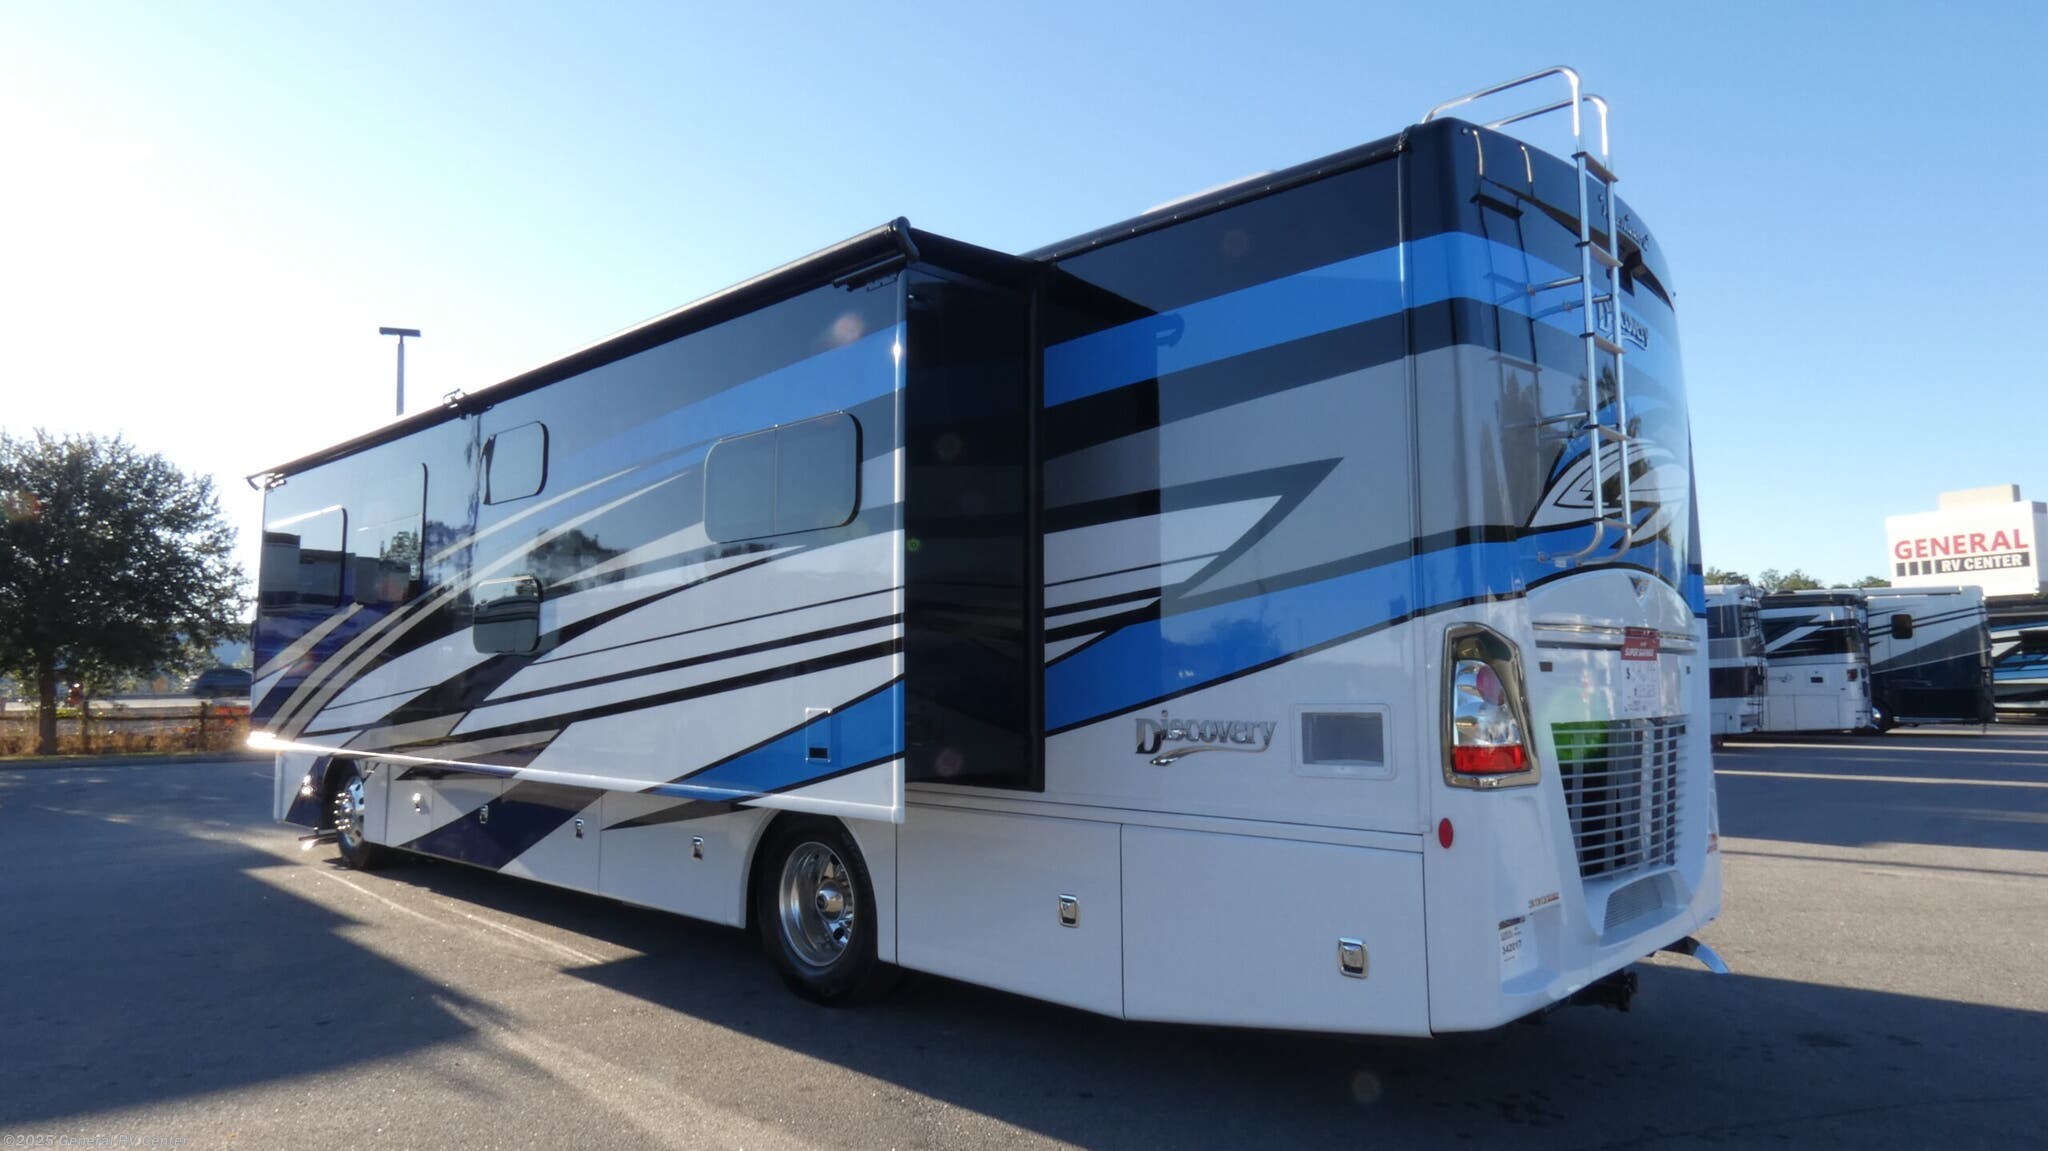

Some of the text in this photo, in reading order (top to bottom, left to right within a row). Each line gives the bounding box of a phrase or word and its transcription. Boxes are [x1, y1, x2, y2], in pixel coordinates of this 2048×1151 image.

[1894, 528, 2029, 560] GENERAL
[1941, 553, 2023, 572] RV CENTER
[1135, 709, 1278, 767] Discovery
